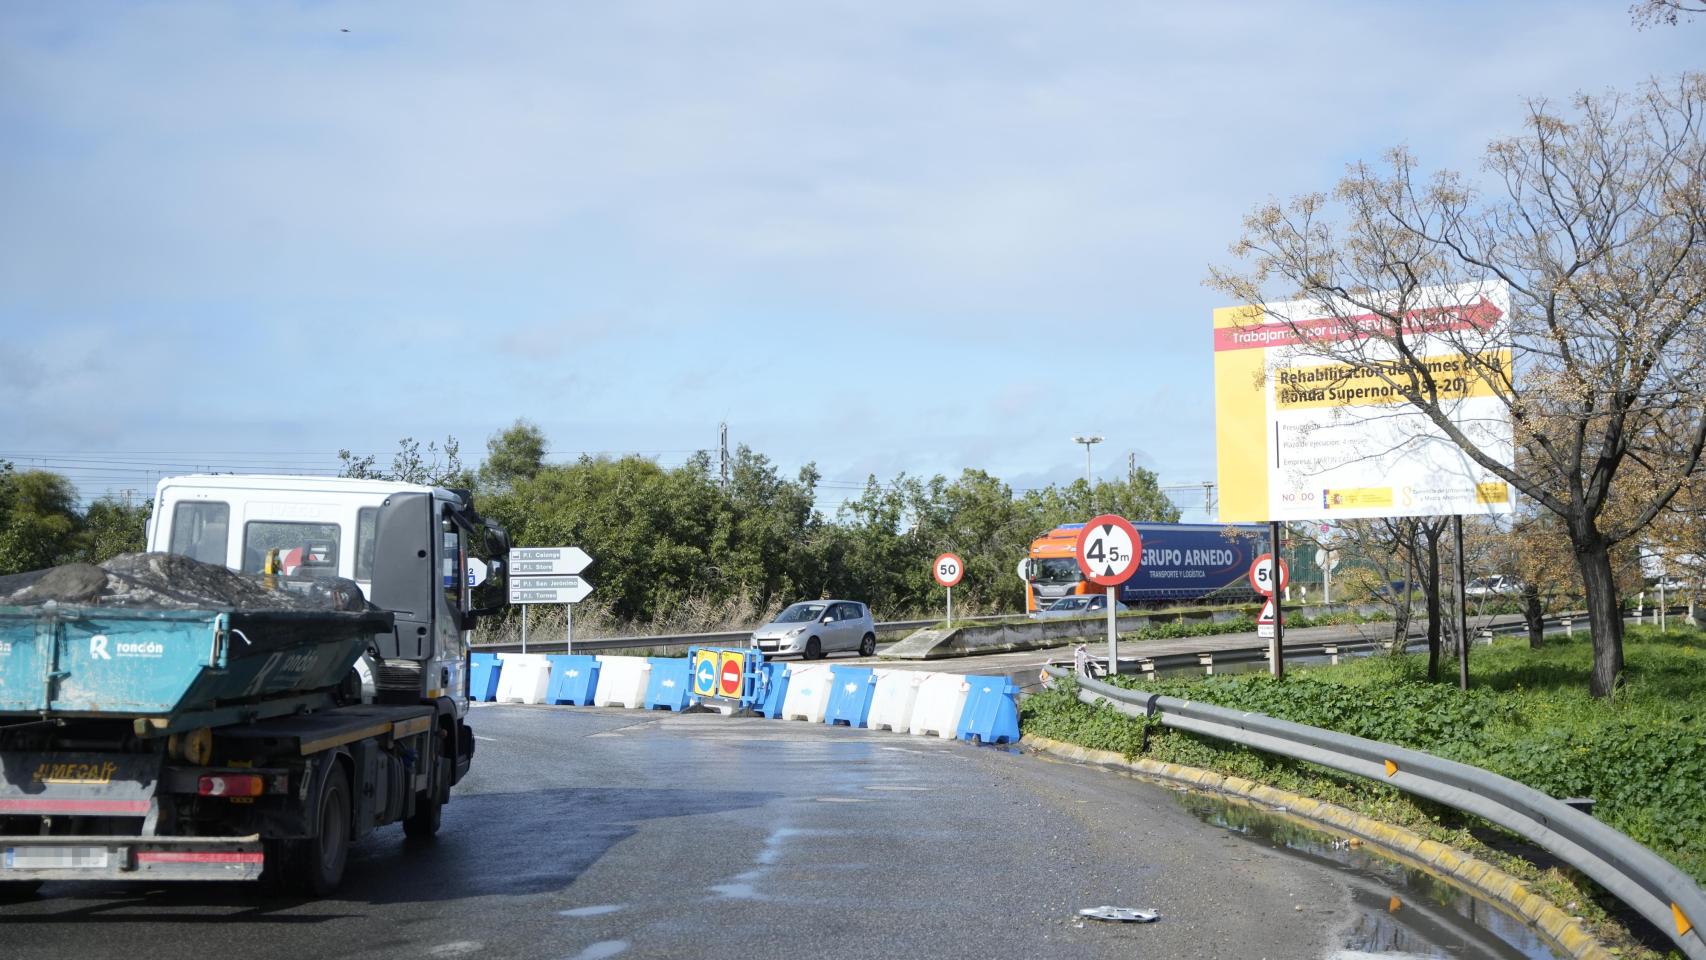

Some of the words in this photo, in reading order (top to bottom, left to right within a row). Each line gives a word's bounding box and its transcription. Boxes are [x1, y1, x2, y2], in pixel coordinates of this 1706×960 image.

[1306, 326, 1327, 338] por
[1409, 356, 1459, 374] rmes
[1329, 381, 1411, 403] Supernorte
[1415, 377, 1468, 395] (S-20)
[1141, 548, 1182, 566] GRUPO
[1184, 548, 1234, 566] ARNEDO
[940, 564, 956, 575] 50
[1149, 570, 1179, 578] TRANSPORTE
